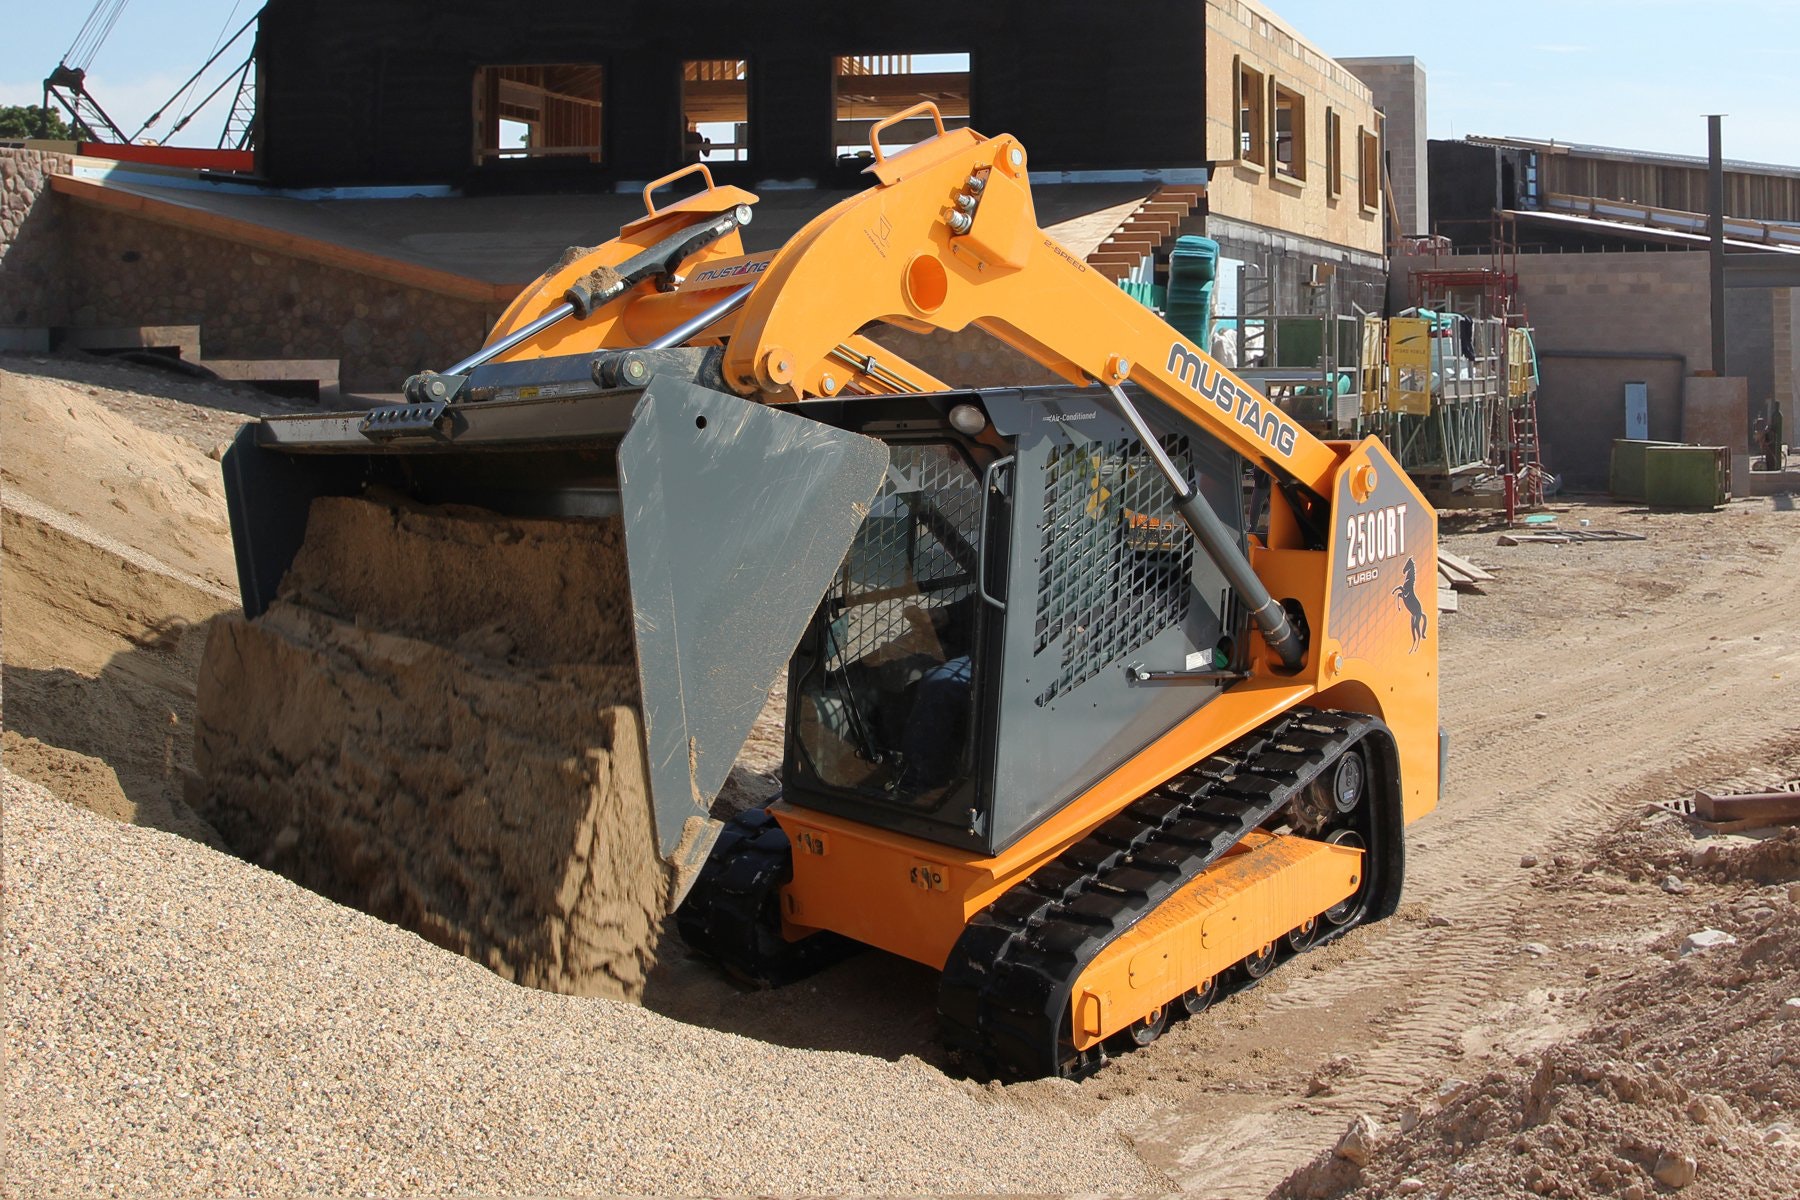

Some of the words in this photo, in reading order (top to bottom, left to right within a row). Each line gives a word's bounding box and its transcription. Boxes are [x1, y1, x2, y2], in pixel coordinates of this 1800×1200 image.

[1043, 239, 1086, 273] 2-SPEED
[695, 260, 771, 282] MUSTANG
[1165, 341, 1297, 458] MUSTANG
[1050, 411, 1097, 422] Air-Conditioned
[1346, 503, 1407, 571] 2500RT
[1346, 567, 1379, 588] TURBO
